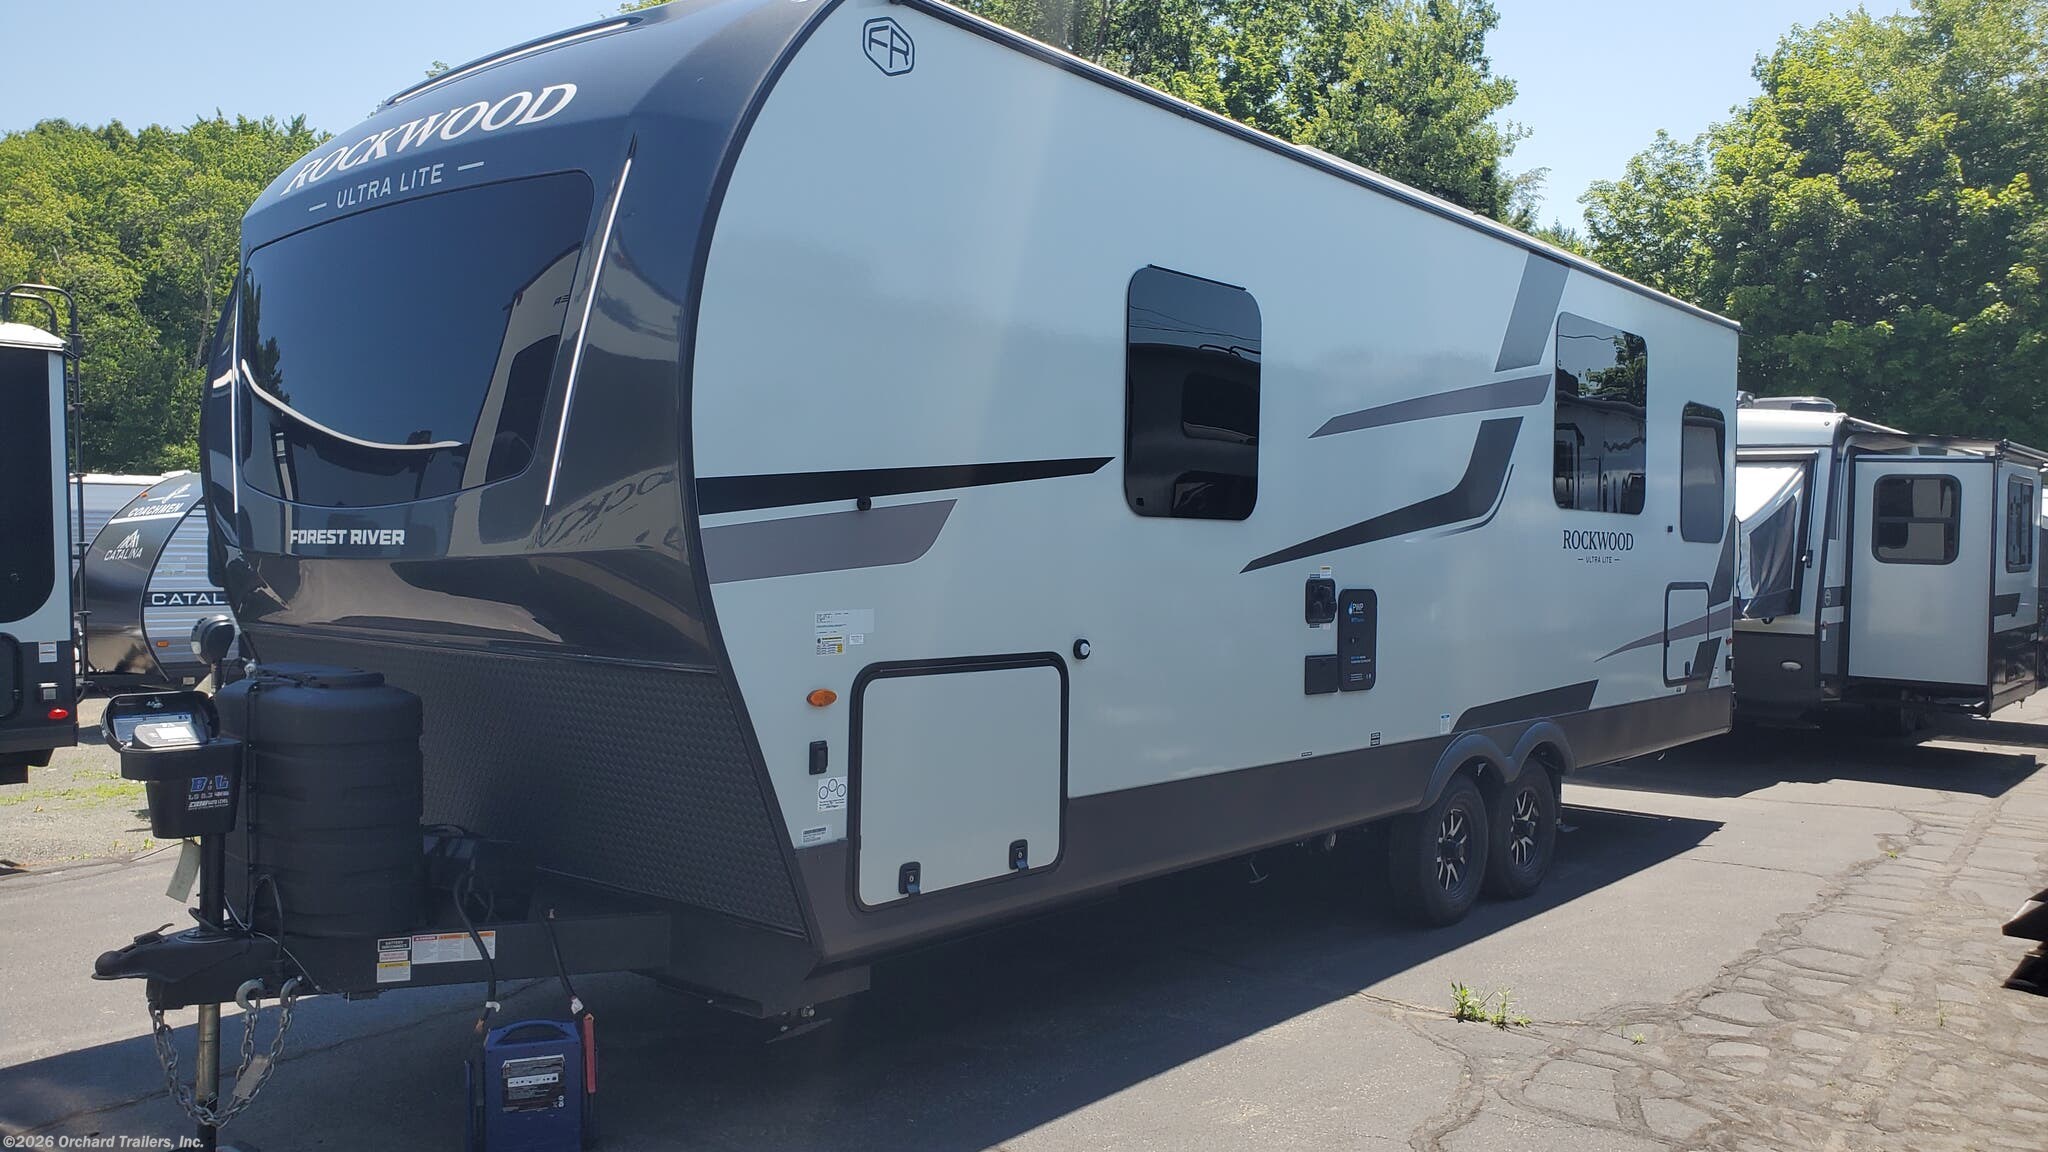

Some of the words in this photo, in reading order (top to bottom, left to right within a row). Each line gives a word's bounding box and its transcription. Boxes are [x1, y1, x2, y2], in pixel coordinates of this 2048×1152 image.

[280, 83, 578, 197] ROCKWOOD
[336, 178, 392, 209] ULTRA
[399, 163, 445, 192] LITE
[127, 502, 185, 518] COACHMEN
[289, 529, 348, 545] FOREST
[349, 529, 405, 546] RIVER
[1562, 529, 1634, 551] ROCKWOOD
[103, 548, 144, 562] CATALINA
